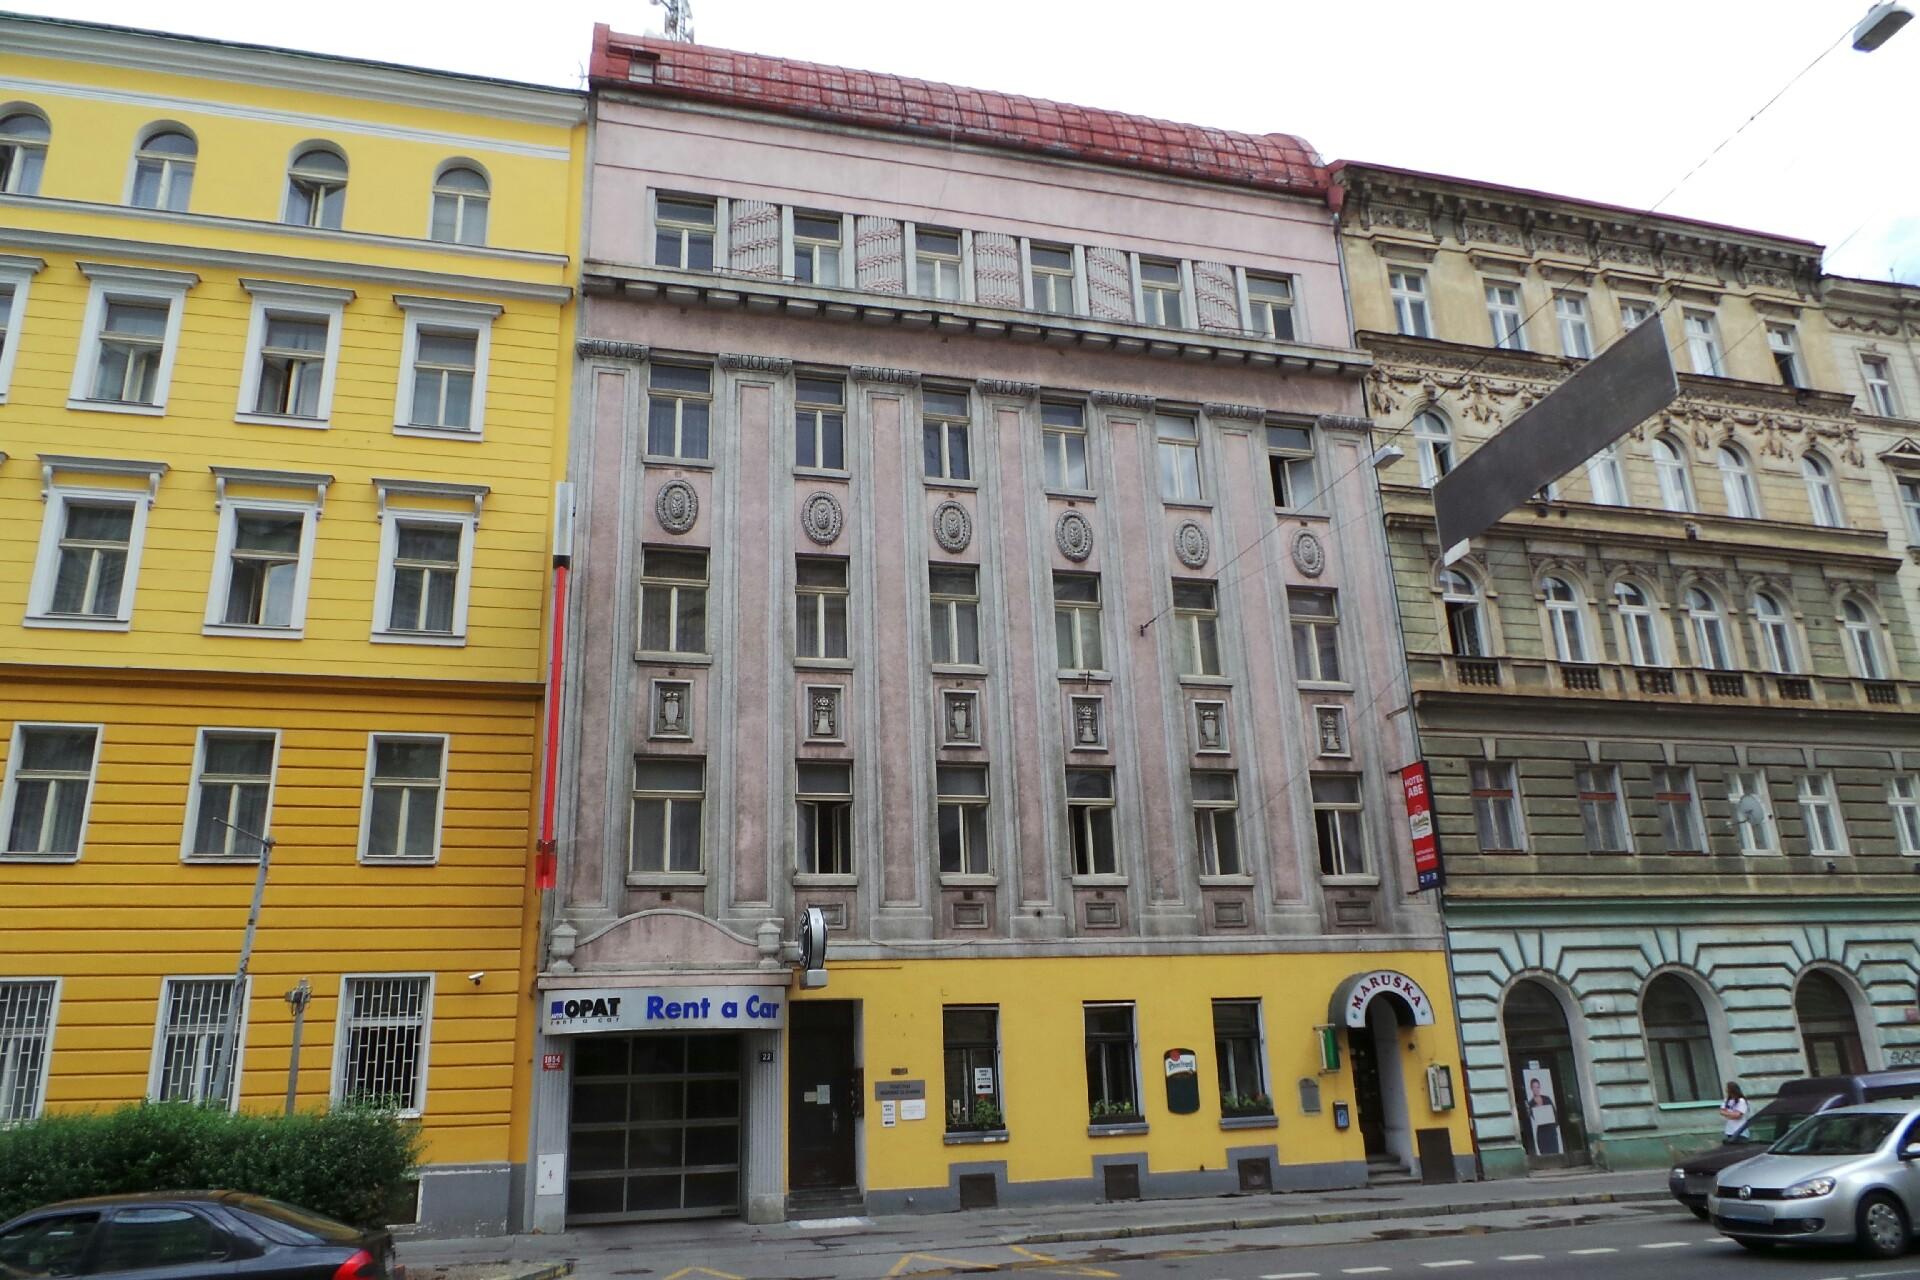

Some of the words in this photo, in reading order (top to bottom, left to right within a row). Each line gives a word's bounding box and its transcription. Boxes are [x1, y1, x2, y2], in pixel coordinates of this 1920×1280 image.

[1404, 775, 1423, 787] HOTEL
[1408, 783, 1424, 798] ABE
[1352, 974, 1421, 1010] MARUŠKA
[565, 998, 621, 1018] OPAT
[647, 996, 710, 1020] Rent
[721, 1002, 738, 1018] a
[746, 995, 779, 1019] Car
